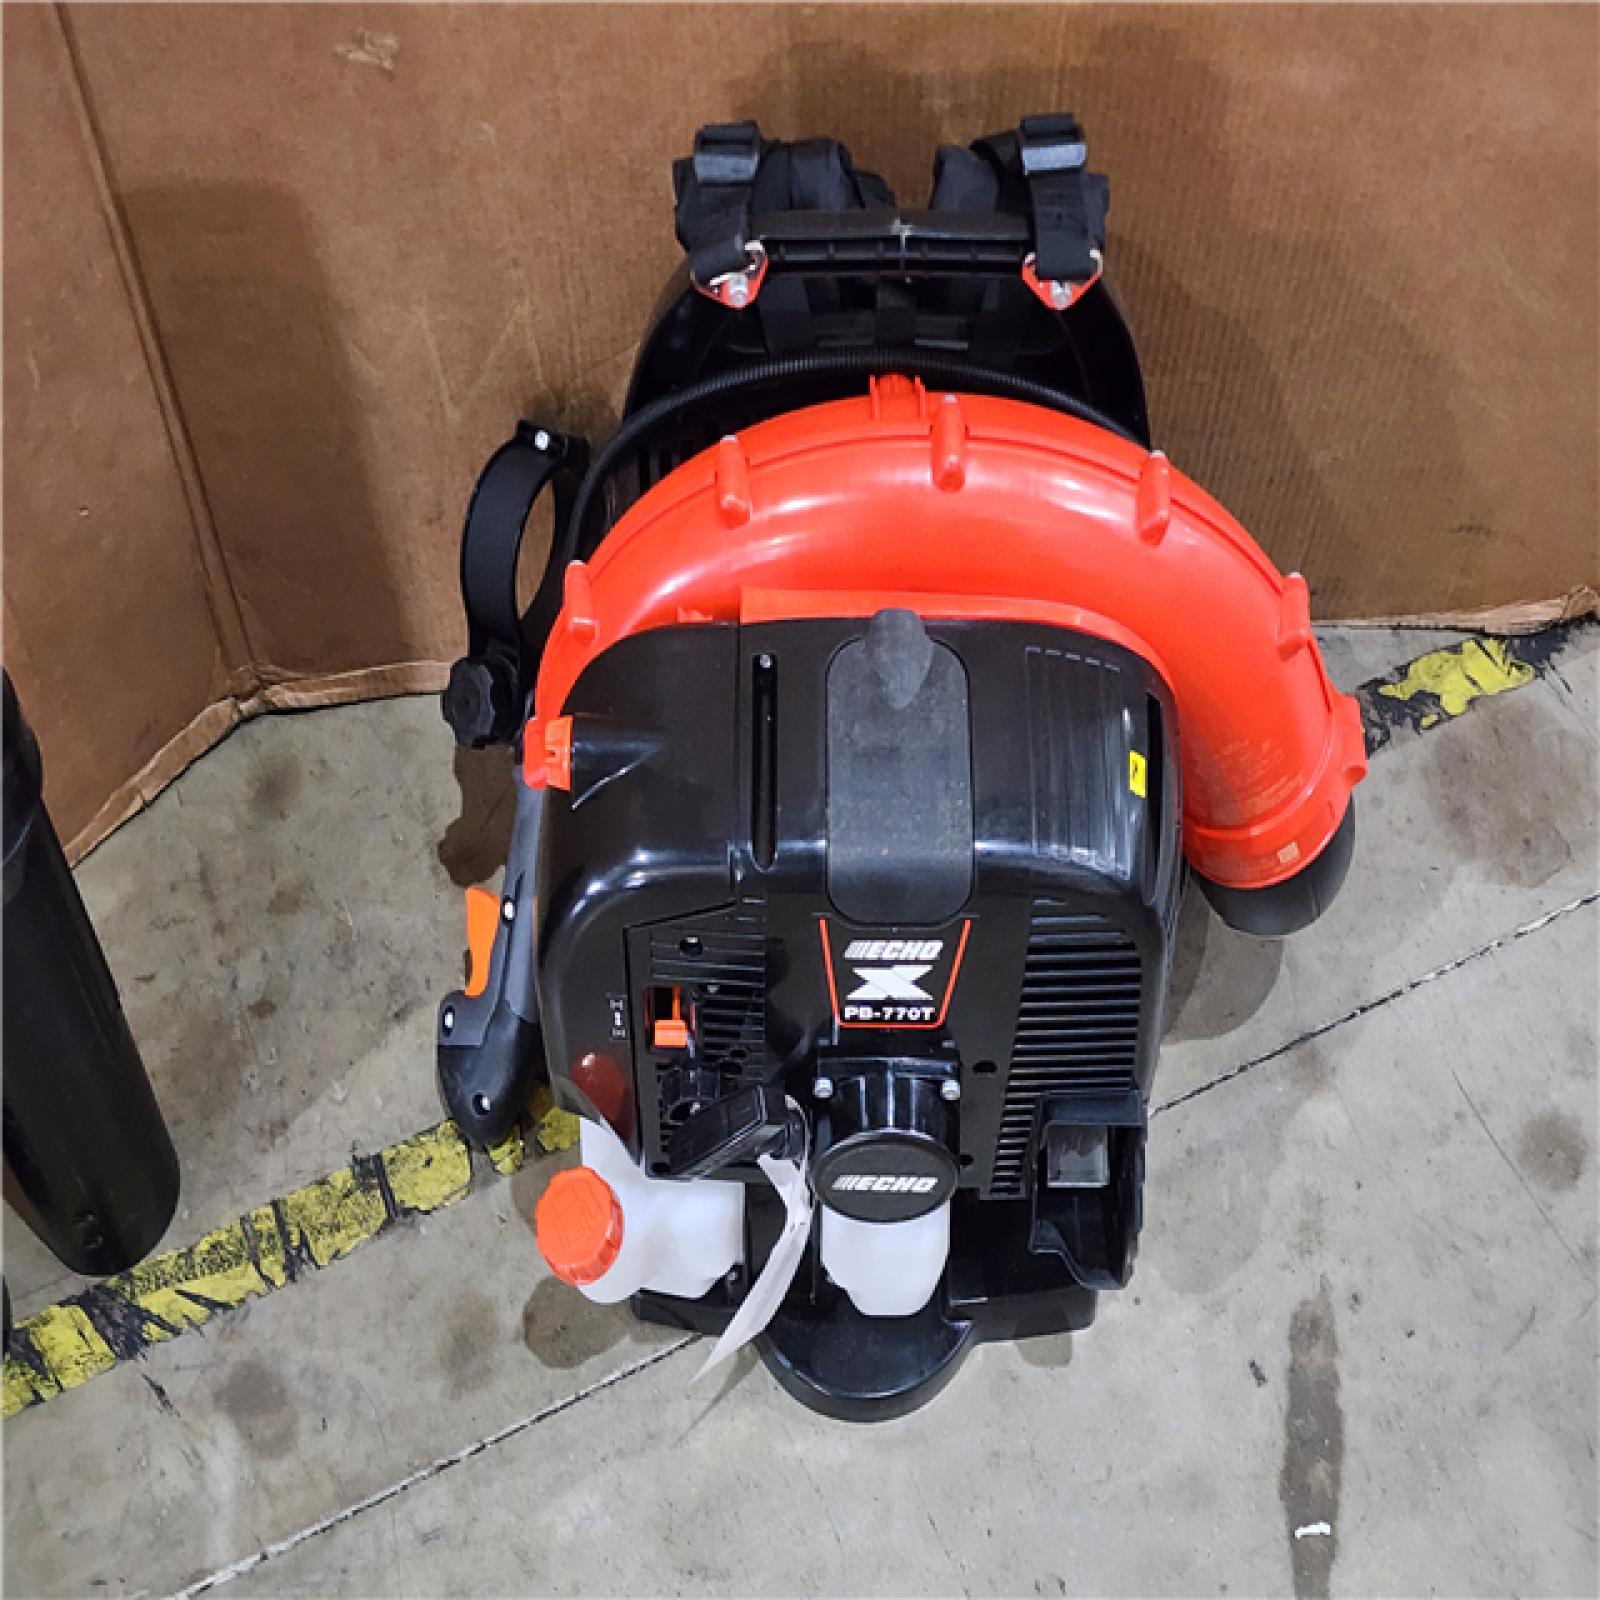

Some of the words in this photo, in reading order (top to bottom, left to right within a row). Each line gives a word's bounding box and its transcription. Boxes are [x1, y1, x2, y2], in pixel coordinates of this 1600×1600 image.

[864, 940, 943, 960] ECHO
[844, 1006, 935, 1021] PB-770T
[853, 1175, 938, 1193] ECHO
